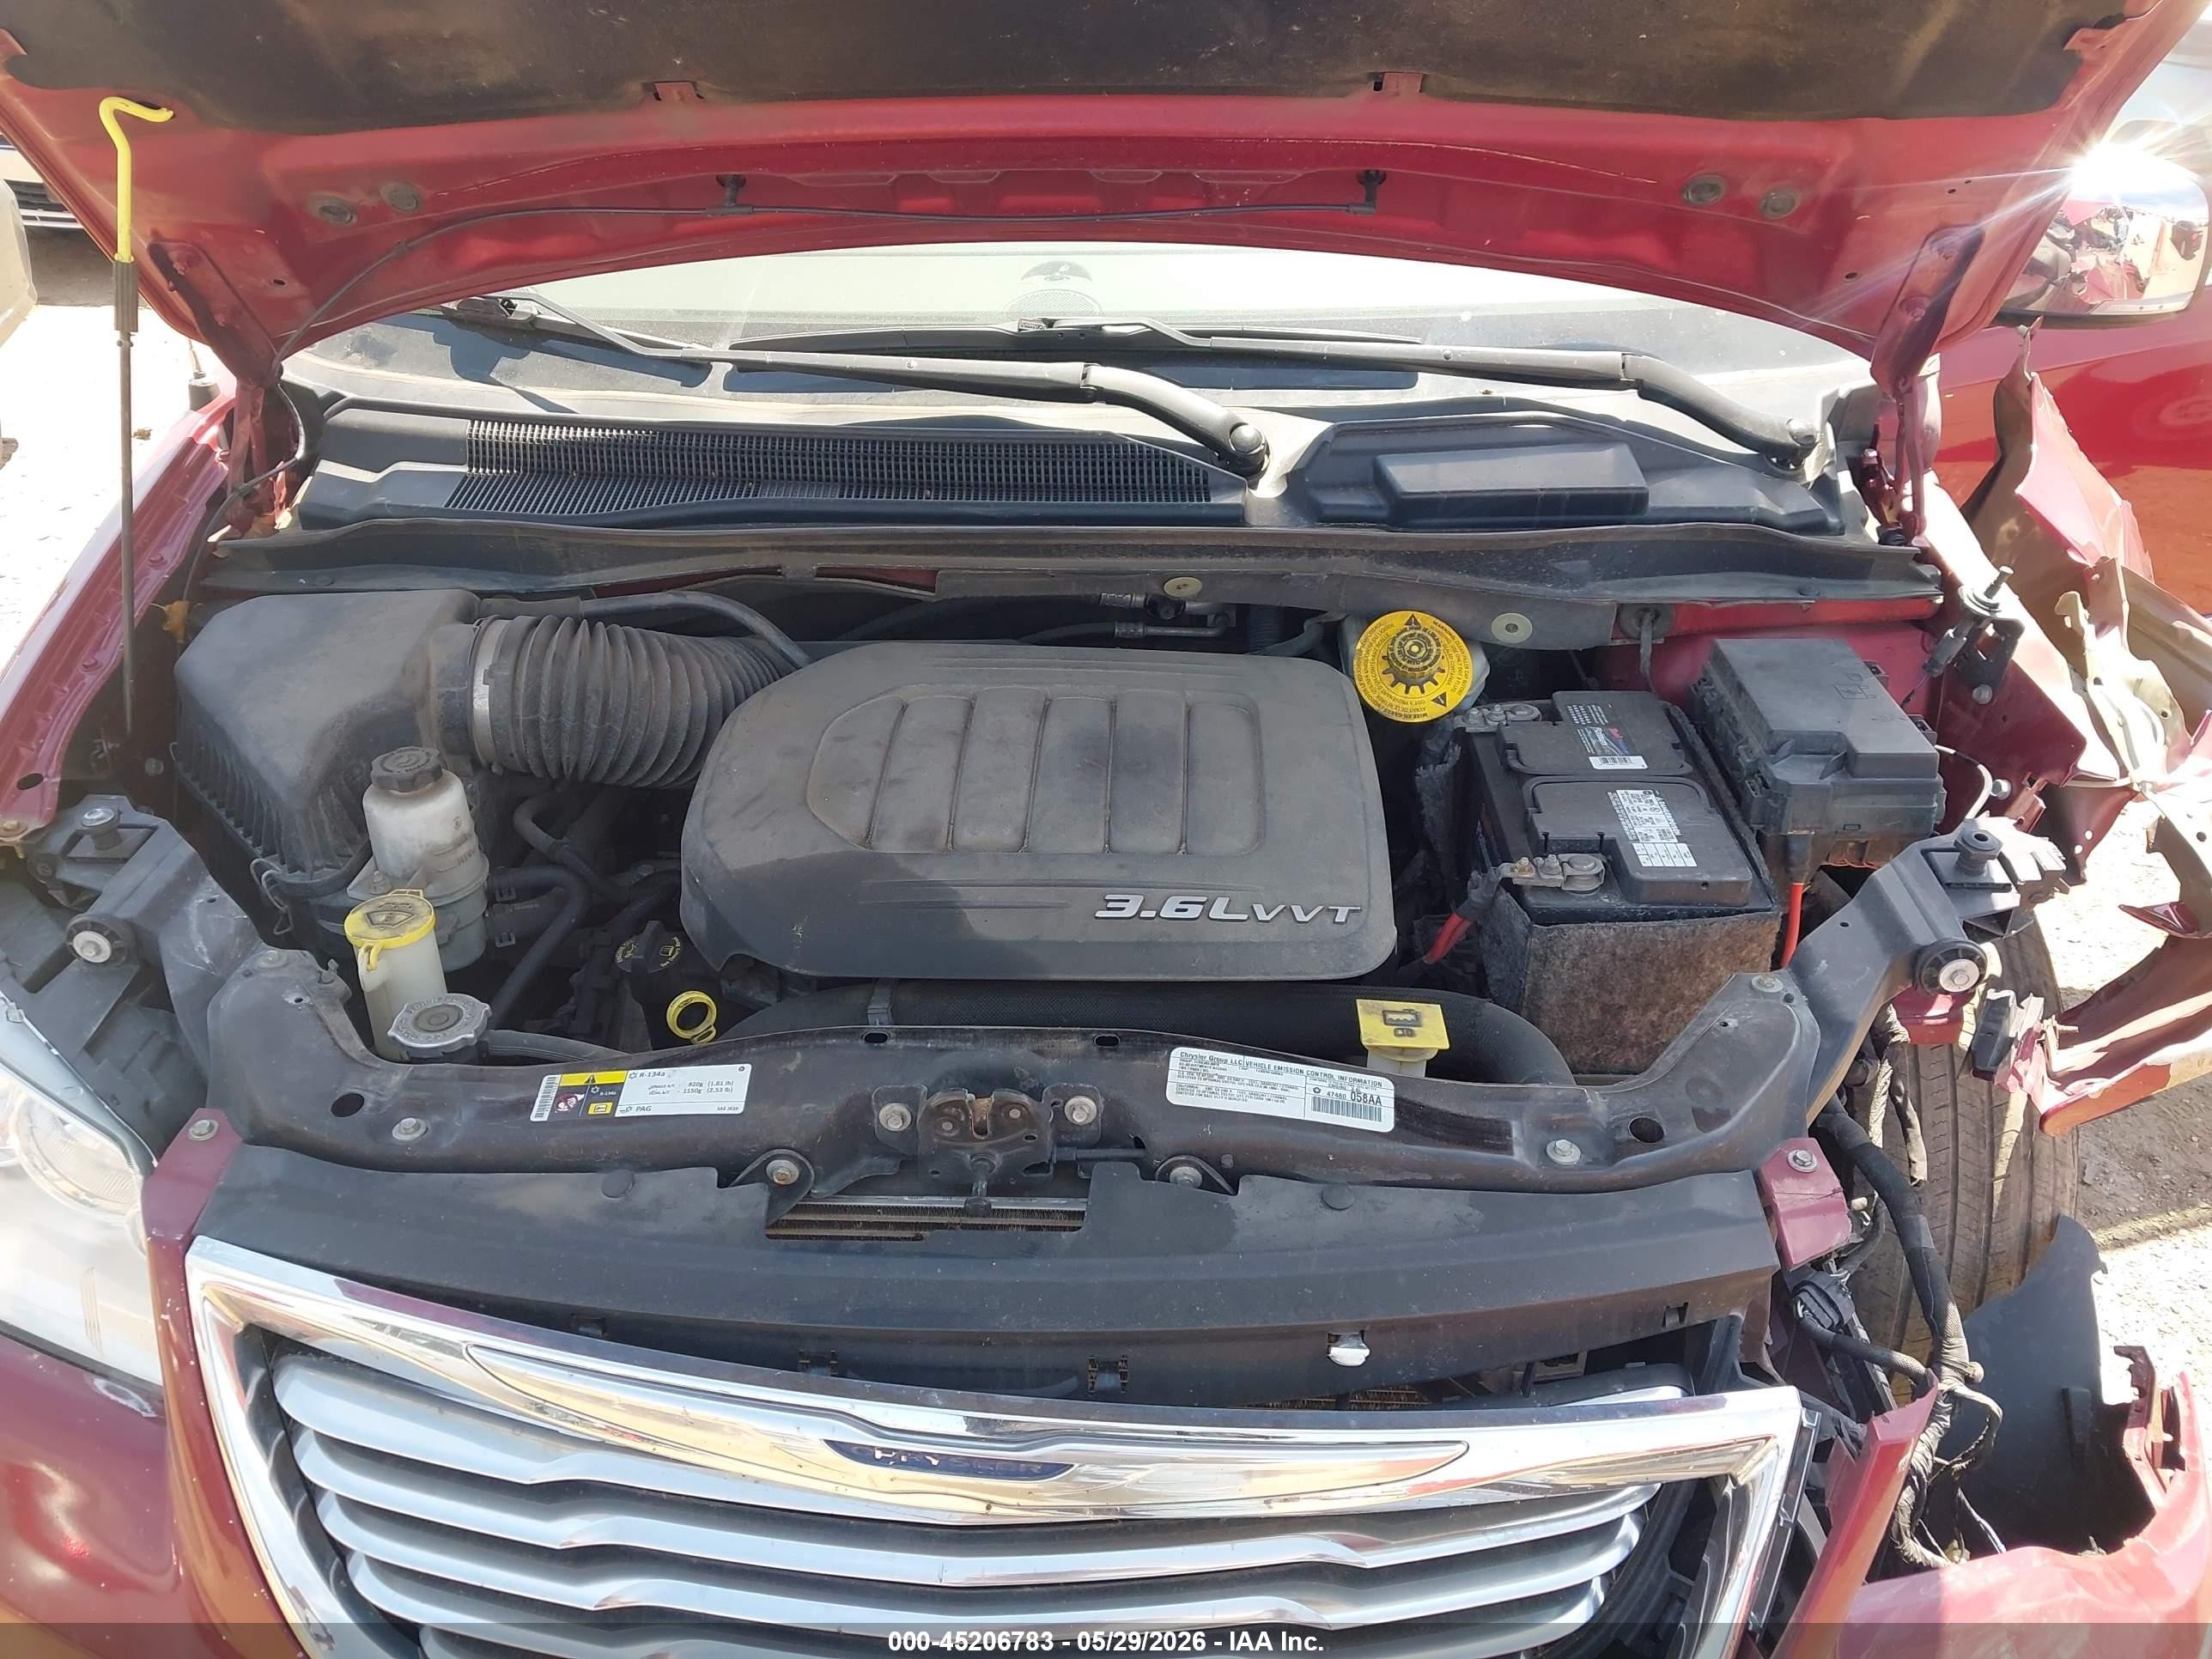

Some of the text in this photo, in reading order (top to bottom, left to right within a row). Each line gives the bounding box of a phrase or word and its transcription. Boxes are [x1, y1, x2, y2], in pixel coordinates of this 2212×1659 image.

[1093, 894, 1362, 925] 3.6L VVT
[1180, 1051, 1206, 1060] Chrysler
[1208, 1054, 1229, 1064] Group
[1245, 1060, 1272, 1070] VEHICLE
[1273, 1064, 1304, 1074] EMISSION
[1306, 1070, 1336, 1080] CONTROL
[1337, 1074, 1382, 1087] INFORMATION
[1350, 1091, 1382, 1106] 058AA
